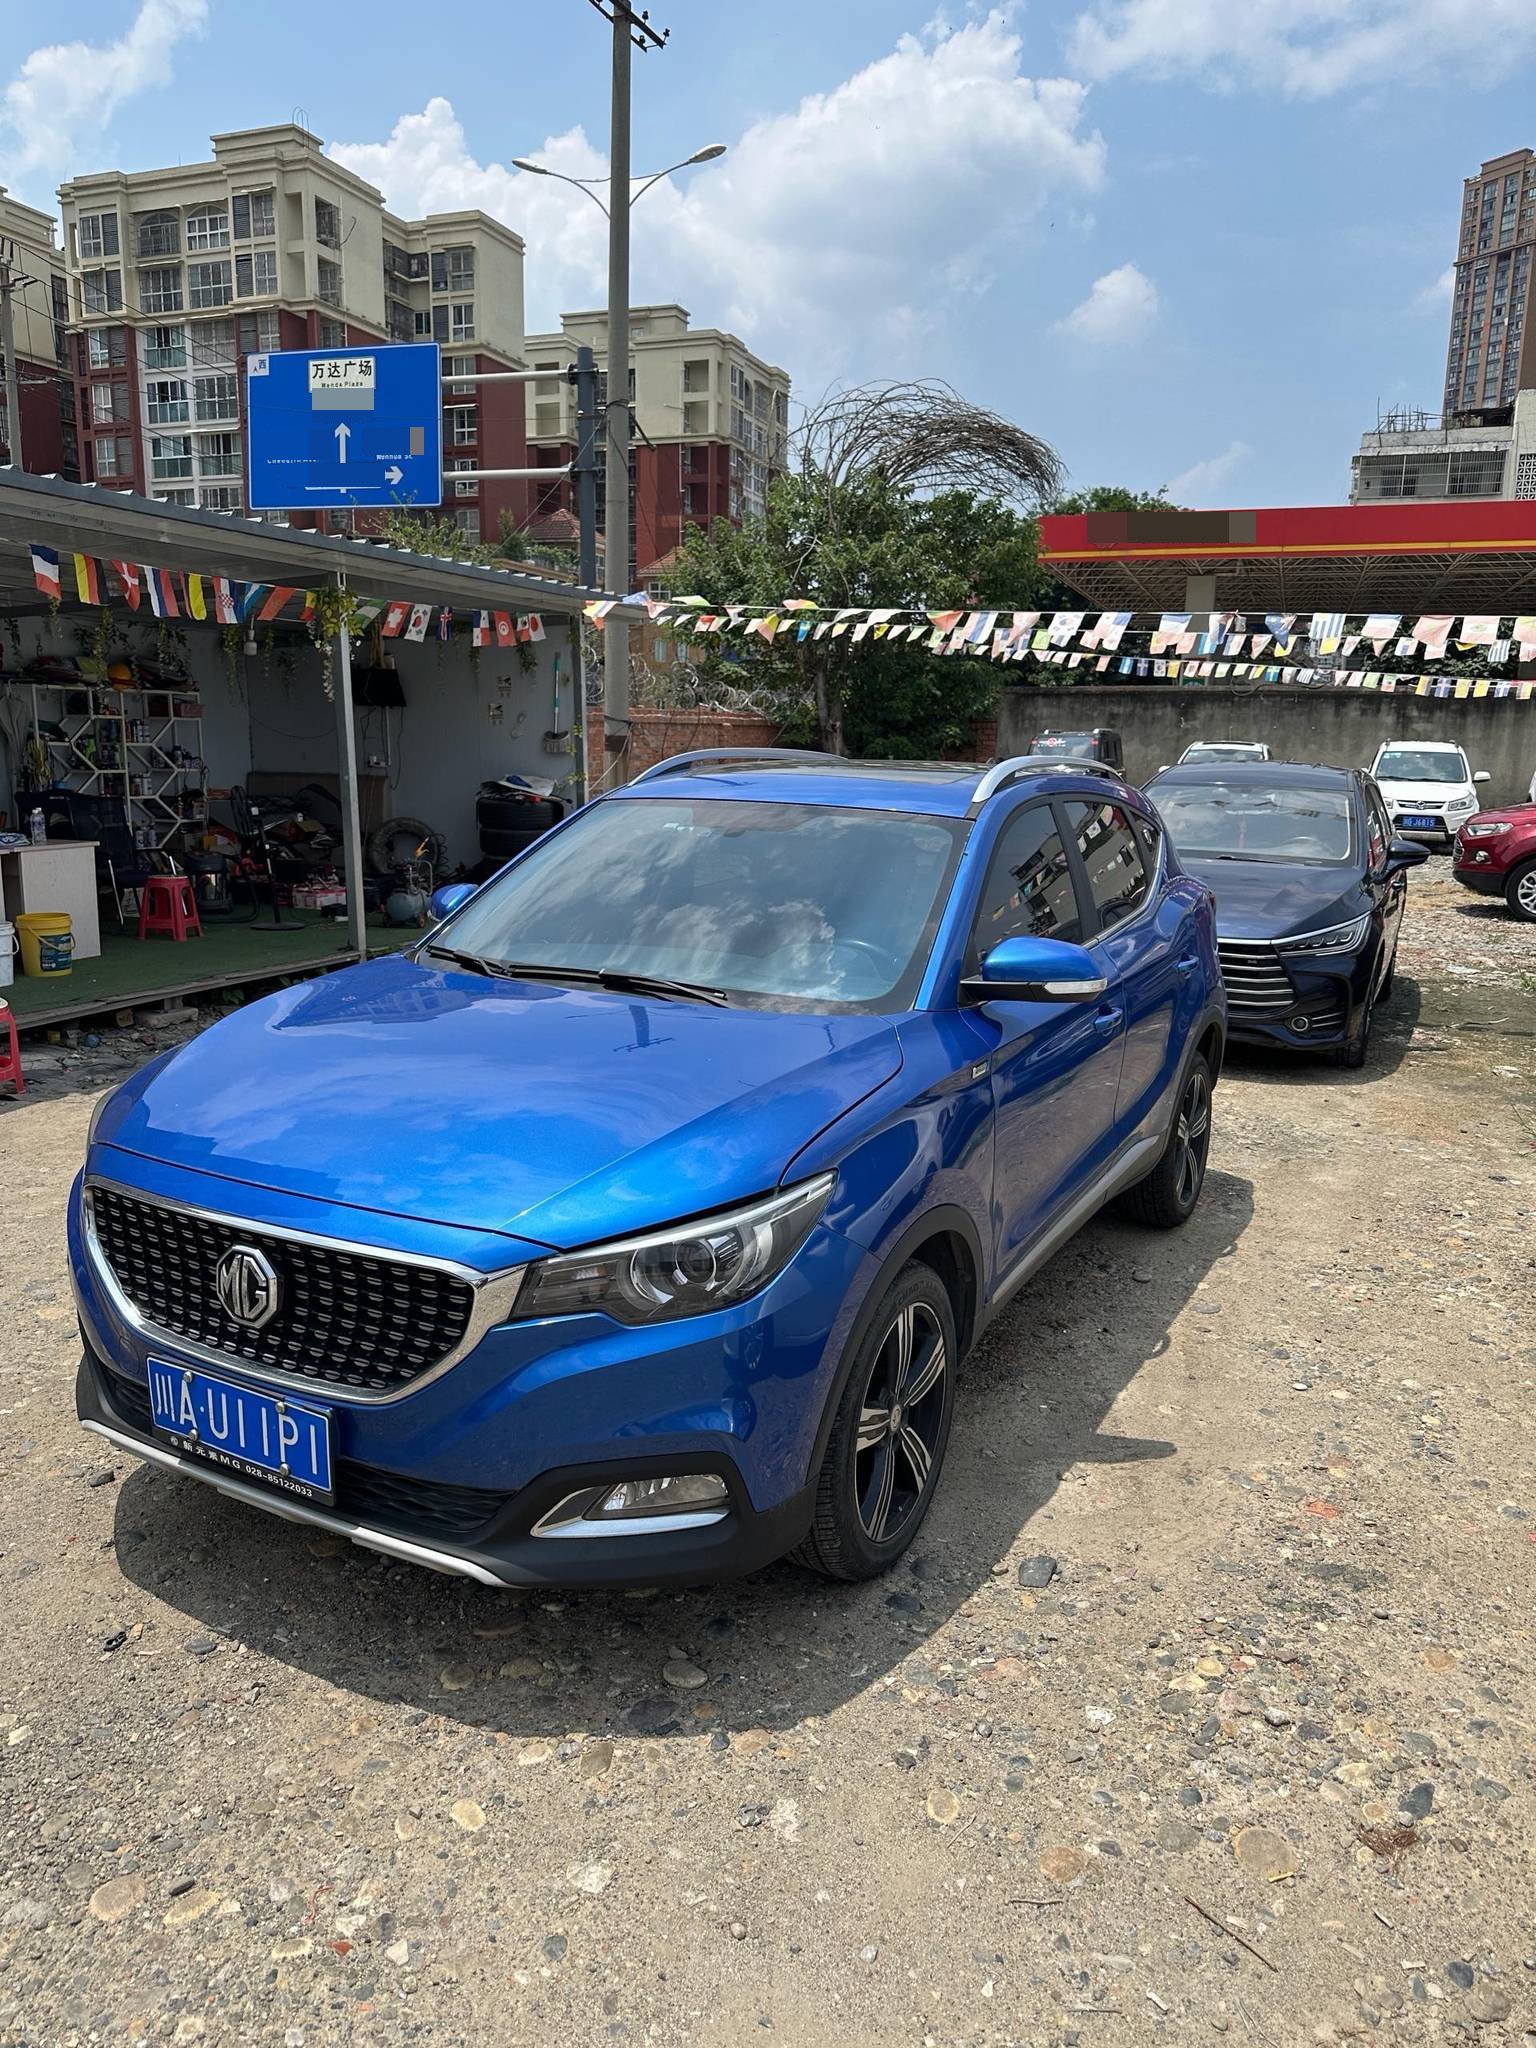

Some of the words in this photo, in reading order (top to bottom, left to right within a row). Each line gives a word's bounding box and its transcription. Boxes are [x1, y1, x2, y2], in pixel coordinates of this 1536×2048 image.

[312, 360, 372, 379] 万达广场
[219, 1252, 269, 1320] MG
[245, 1465, 313, 1497] 028-85122033
